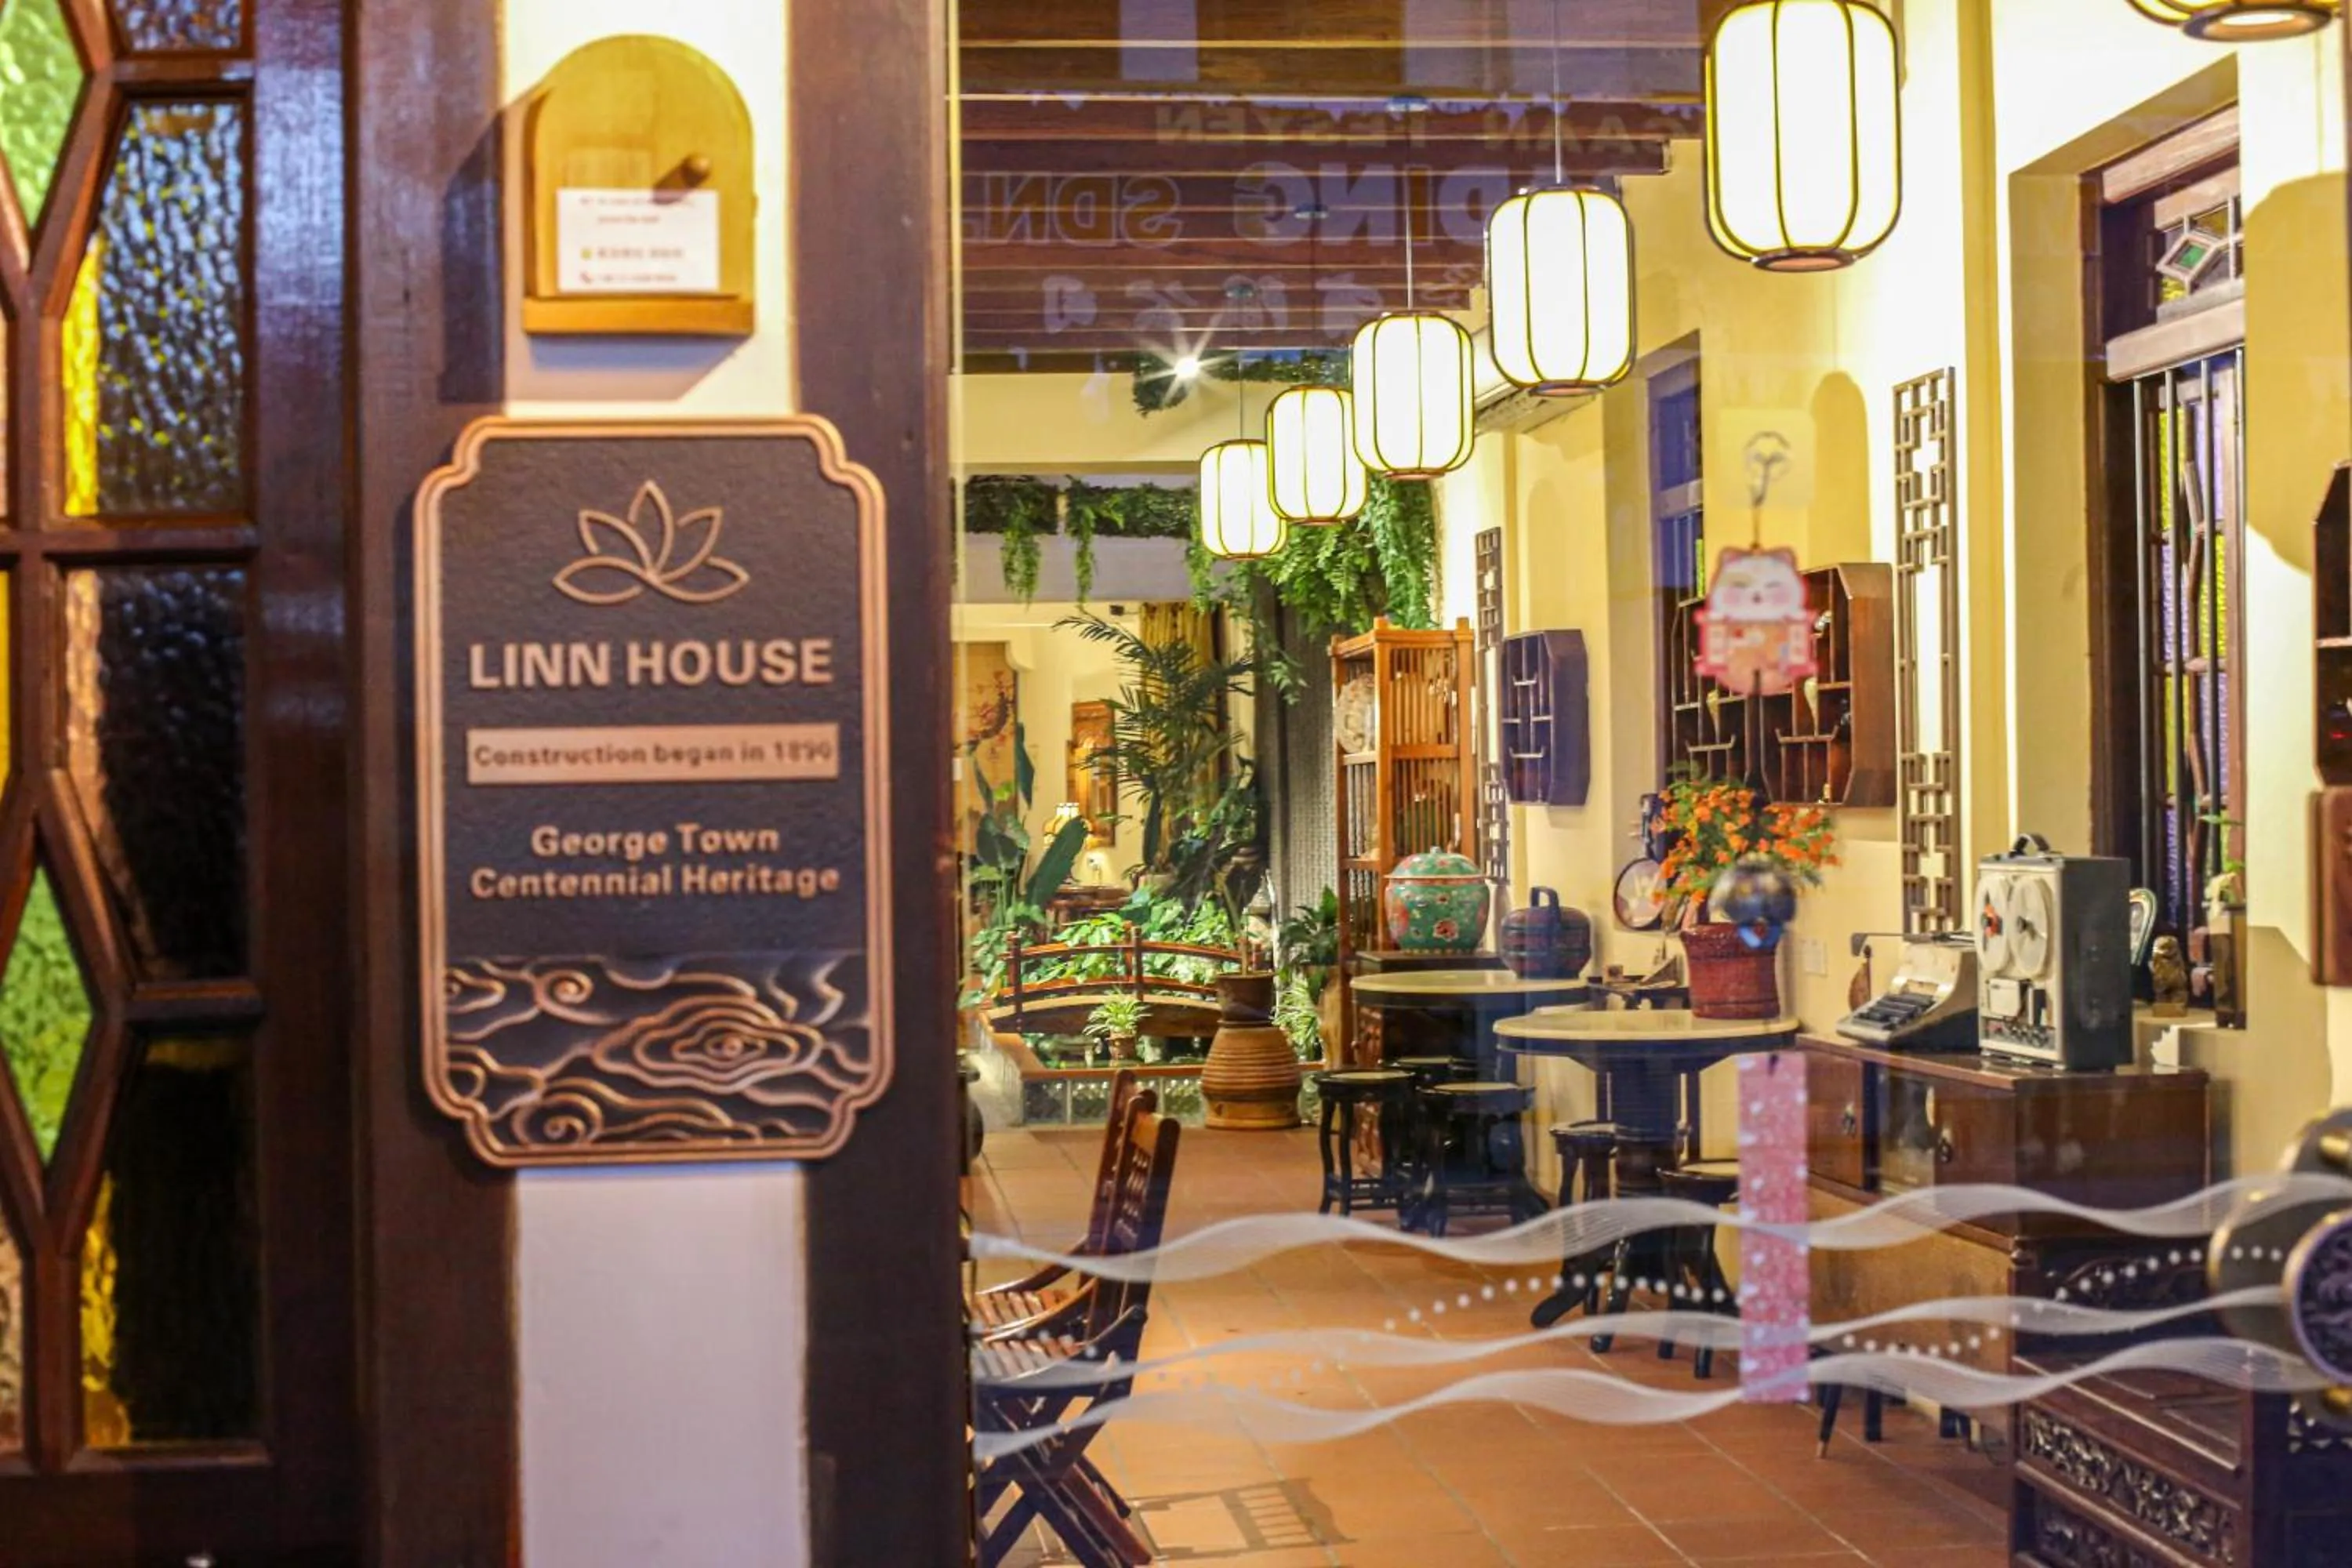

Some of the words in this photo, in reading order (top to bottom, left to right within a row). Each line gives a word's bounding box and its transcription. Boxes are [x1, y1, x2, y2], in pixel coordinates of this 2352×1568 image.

[469, 641, 612, 688] LINN
[628, 637, 834, 686] HOUSE
[474, 742, 648, 768] Construction
[653, 741, 735, 768] began
[740, 740, 765, 763] in
[531, 825, 669, 860] George
[674, 822, 780, 852] Town
[470, 865, 673, 898] Centennial
[681, 862, 841, 898] Heritage
